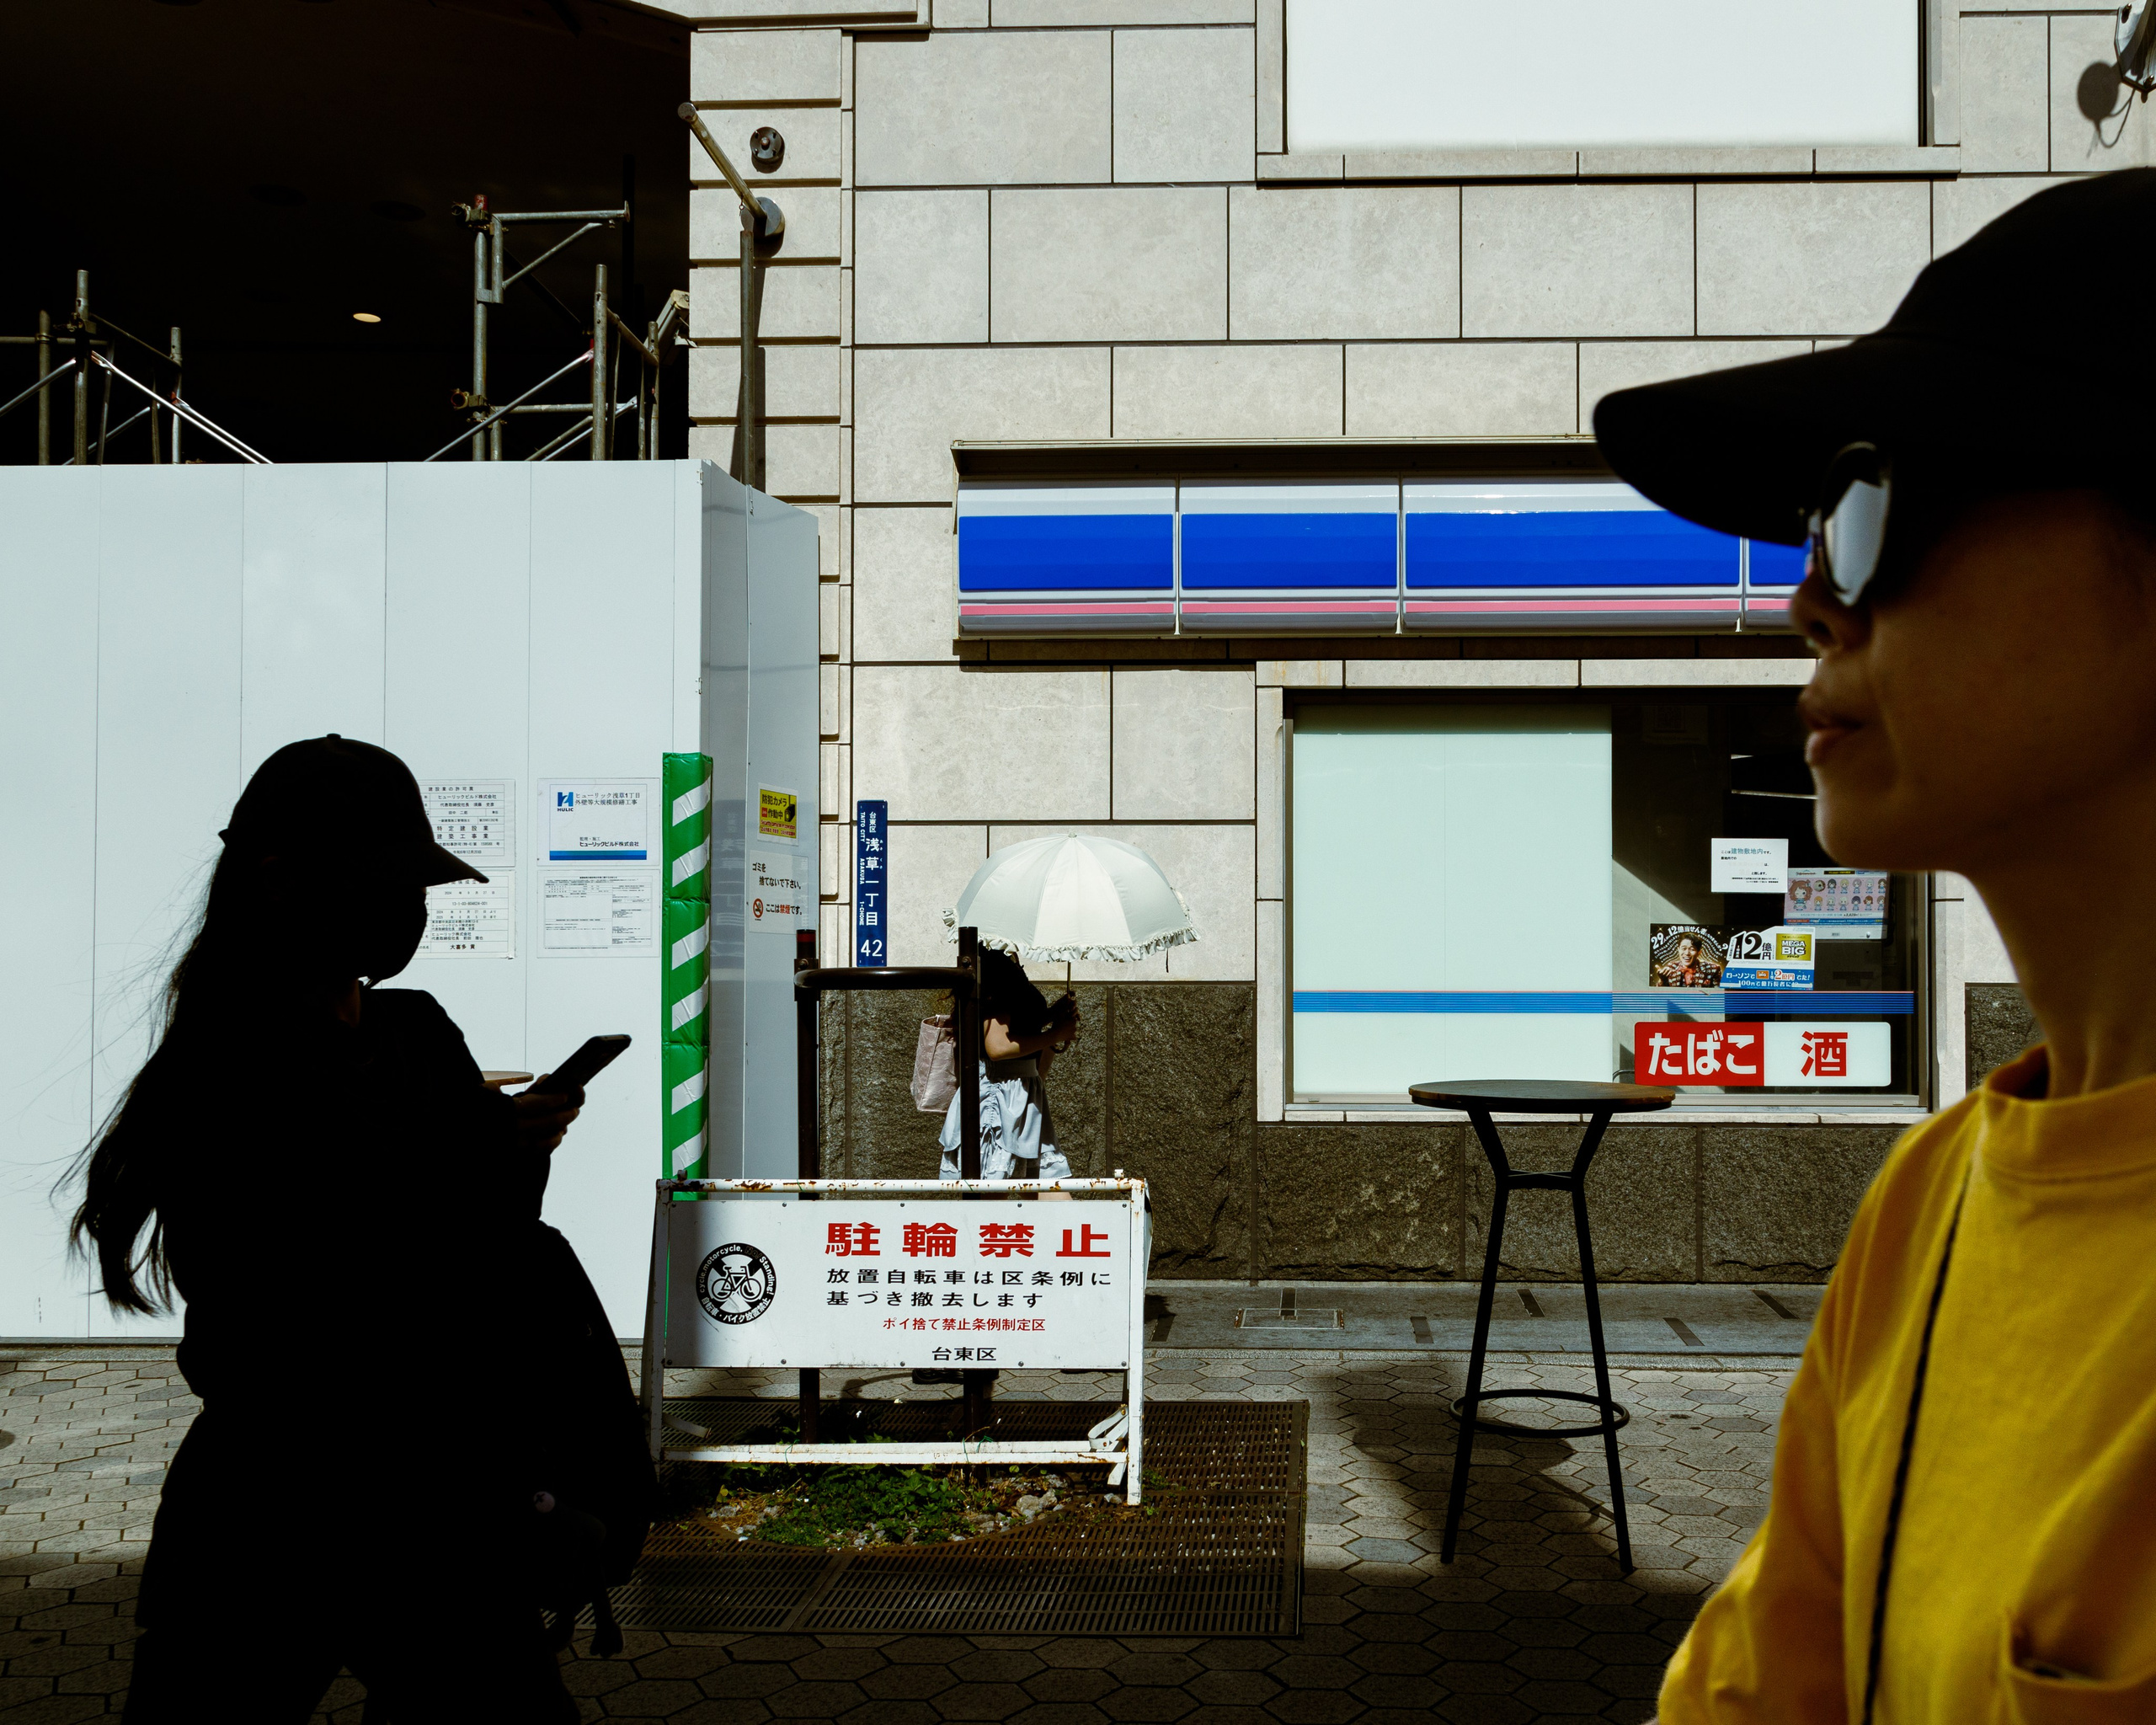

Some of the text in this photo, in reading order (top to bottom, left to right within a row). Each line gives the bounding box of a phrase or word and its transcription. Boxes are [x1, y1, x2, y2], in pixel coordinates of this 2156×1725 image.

[762, 793, 787, 807] 防犯カメラ
[768, 809, 783, 820] 作動中
[752, 862, 766, 873] ゴミを
[759, 876, 801, 889] 捨てないで下さい。
[866, 838, 879, 926] 浅草一丁目
[766, 904, 802, 916] ここは禁煙です。
[861, 939, 883, 957] 42
[1781, 947, 1806, 955] BIG
[1648, 1029, 1848, 1076] たばこ 酒
[825, 1221, 1111, 1258] 駐輪禁止
[759, 1256, 775, 1295] Standing!
[826, 1268, 1113, 1288] 放置自転車は区条例に
[826, 1290, 1044, 1308] 基づき撤去します
[702, 1297, 771, 1323] 自転車・バイク放置禁止
[883, 1317, 1046, 1332] ポイ捨て禁止条例制定区
[932, 1346, 997, 1362] 台東区
